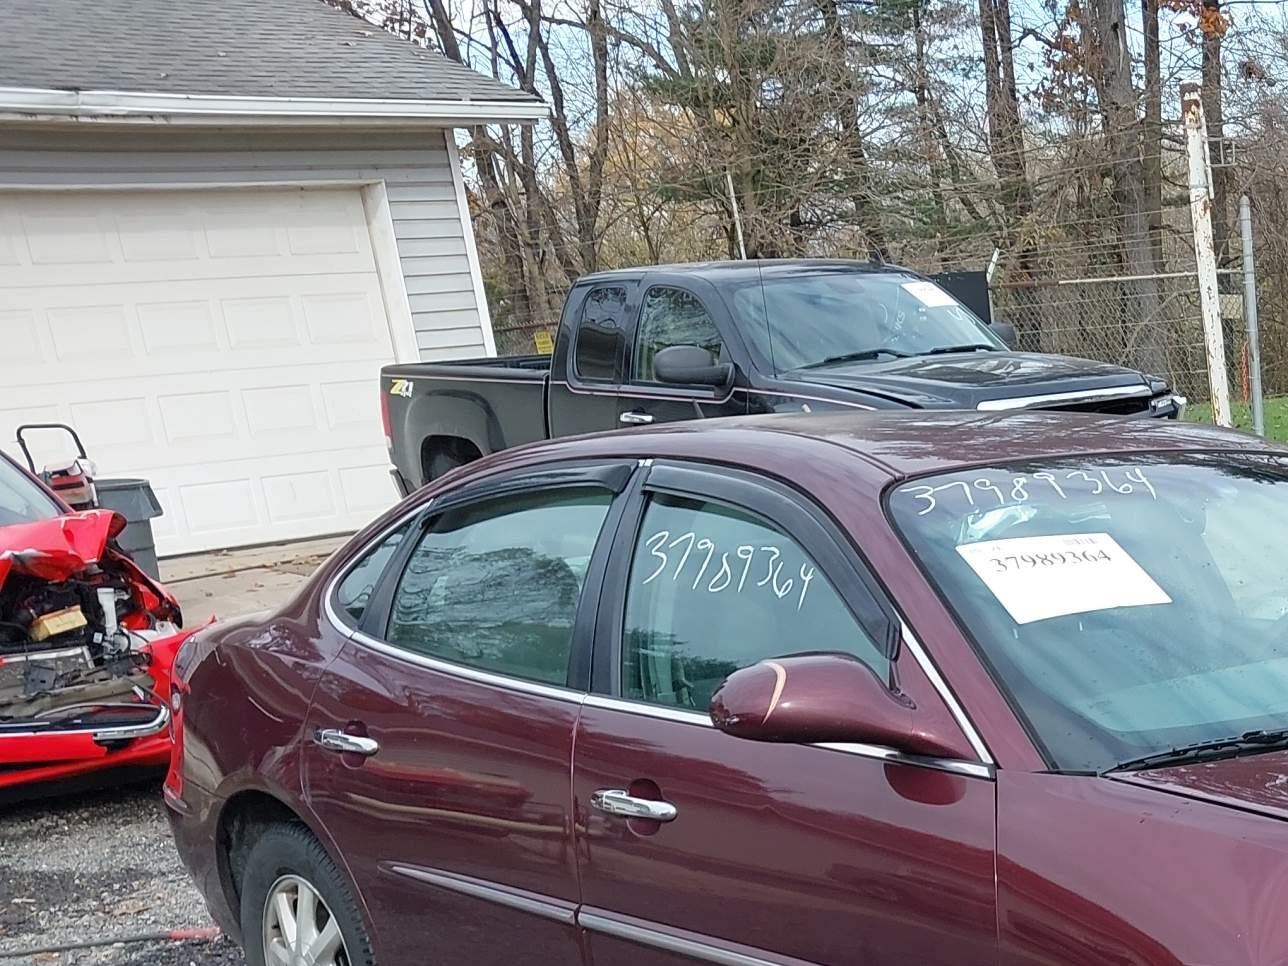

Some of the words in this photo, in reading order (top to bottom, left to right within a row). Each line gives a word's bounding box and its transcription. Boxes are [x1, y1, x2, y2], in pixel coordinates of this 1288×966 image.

[899, 467, 1157, 516] 37989364
[642, 530, 815, 611] 37989364
[988, 549, 1112, 574] 37989364
